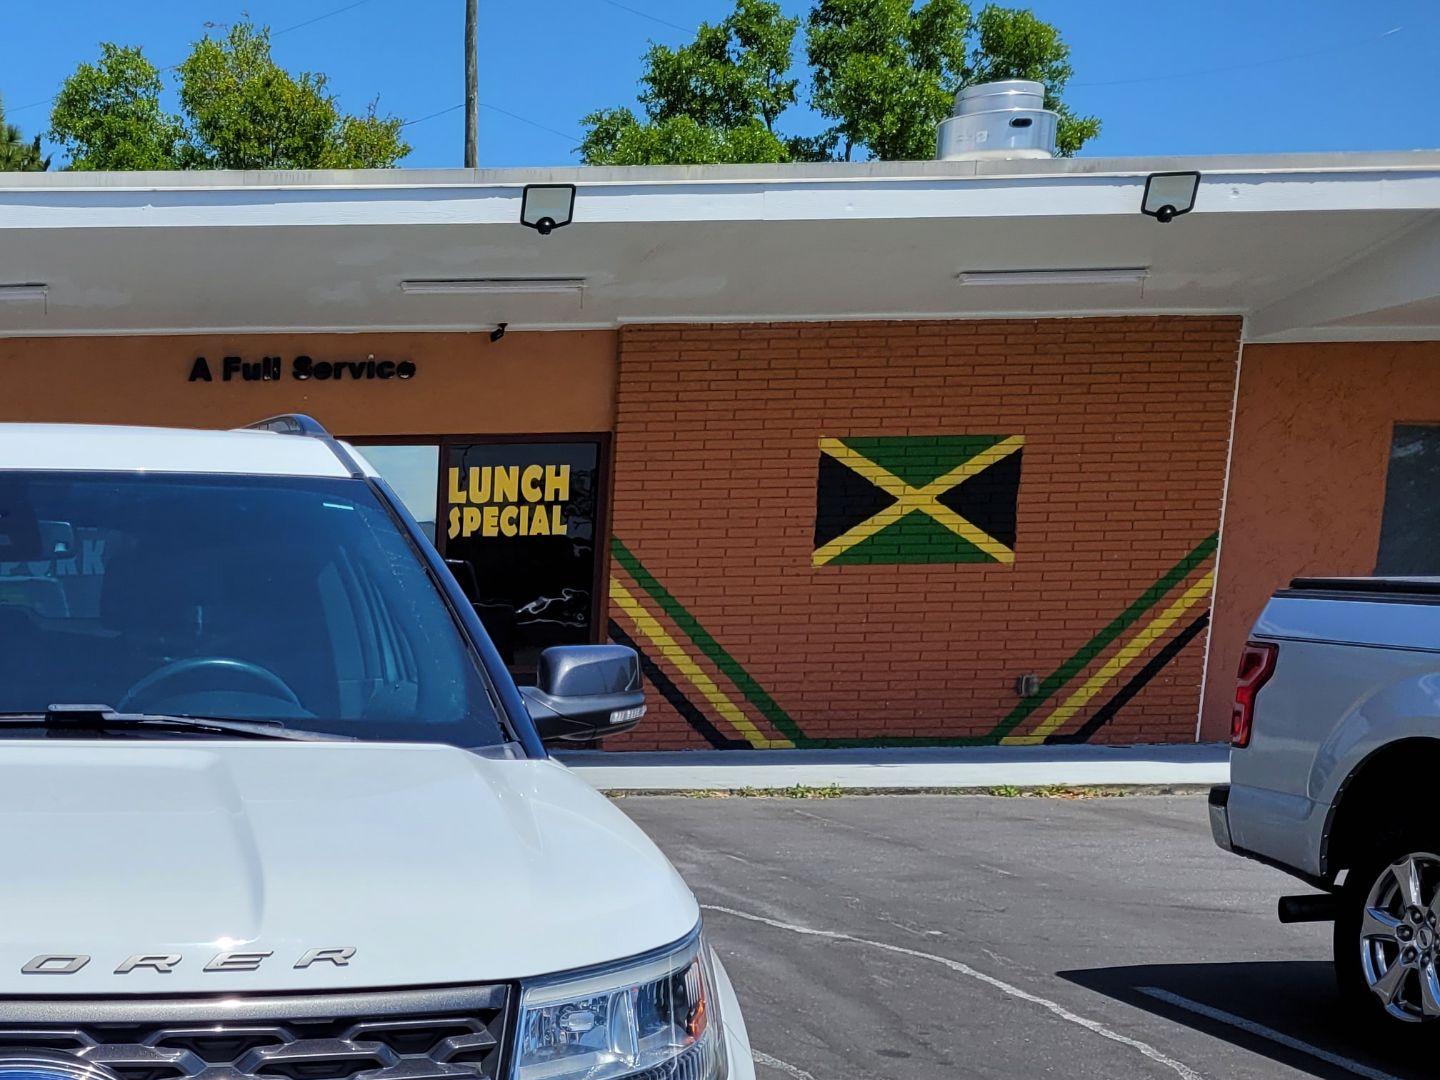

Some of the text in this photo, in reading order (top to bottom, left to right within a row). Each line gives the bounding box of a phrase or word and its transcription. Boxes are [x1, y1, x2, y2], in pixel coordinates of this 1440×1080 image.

[188, 355, 417, 382] A Full Service
[448, 464, 571, 504] LUNCH
[447, 504, 568, 540] SPECIAL
